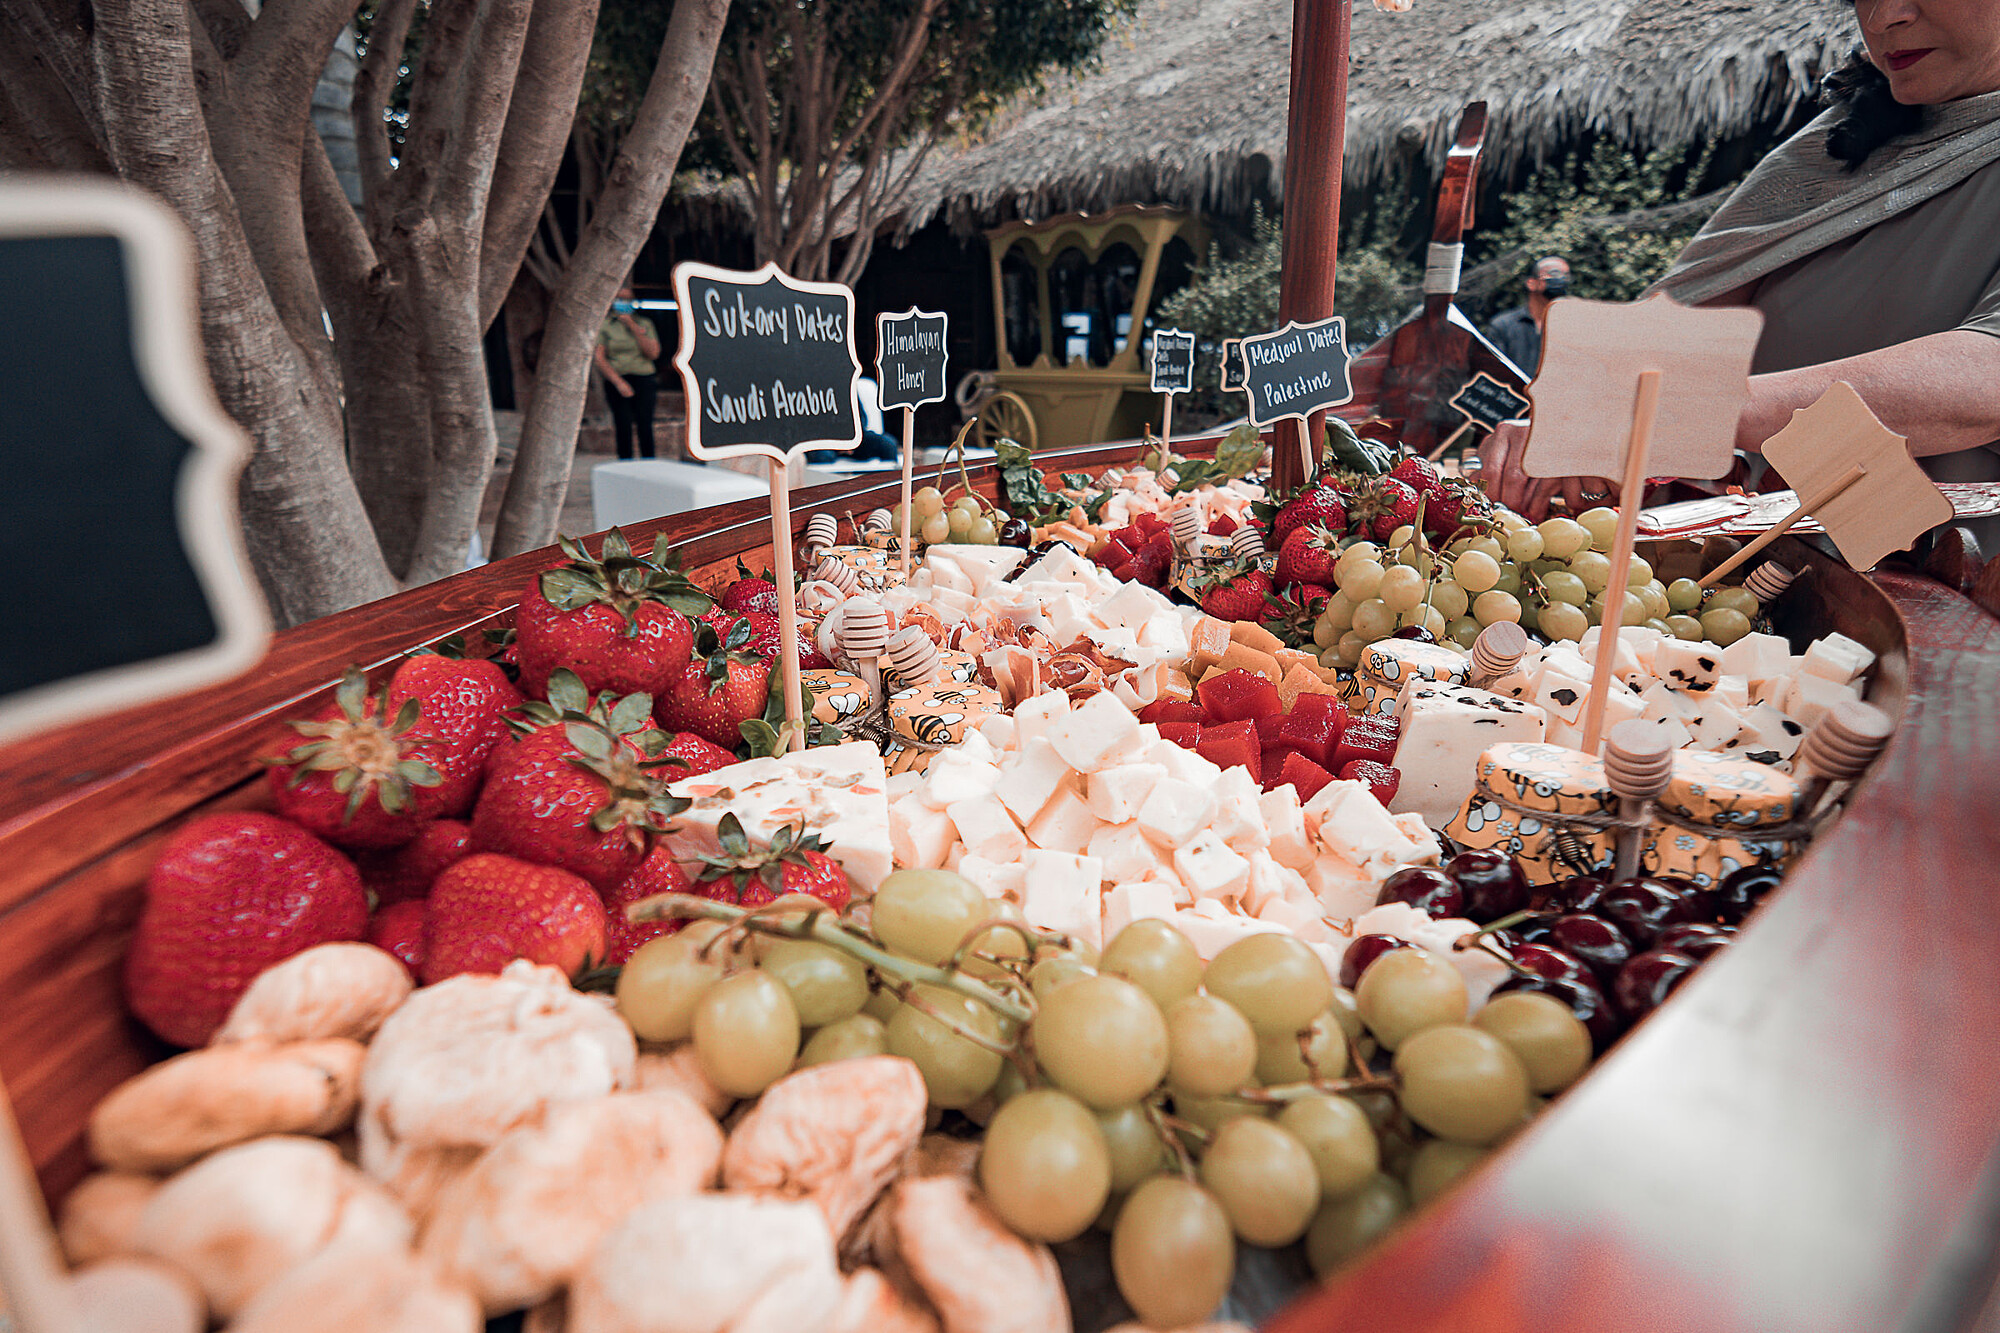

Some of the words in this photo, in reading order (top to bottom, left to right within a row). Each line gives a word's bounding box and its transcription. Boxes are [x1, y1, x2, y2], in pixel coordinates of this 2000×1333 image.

[703, 287, 788, 344] Sukary
[794, 303, 844, 344] Dates
[886, 321, 941, 356] Himalayan
[1249, 335, 1303, 367] Medjoul
[1306, 325, 1341, 353] Dates
[897, 363, 926, 392] Honey
[1263, 370, 1332, 408] Palestine
[706, 377, 767, 425] Saudi
[771, 379, 839, 419] Arabia
